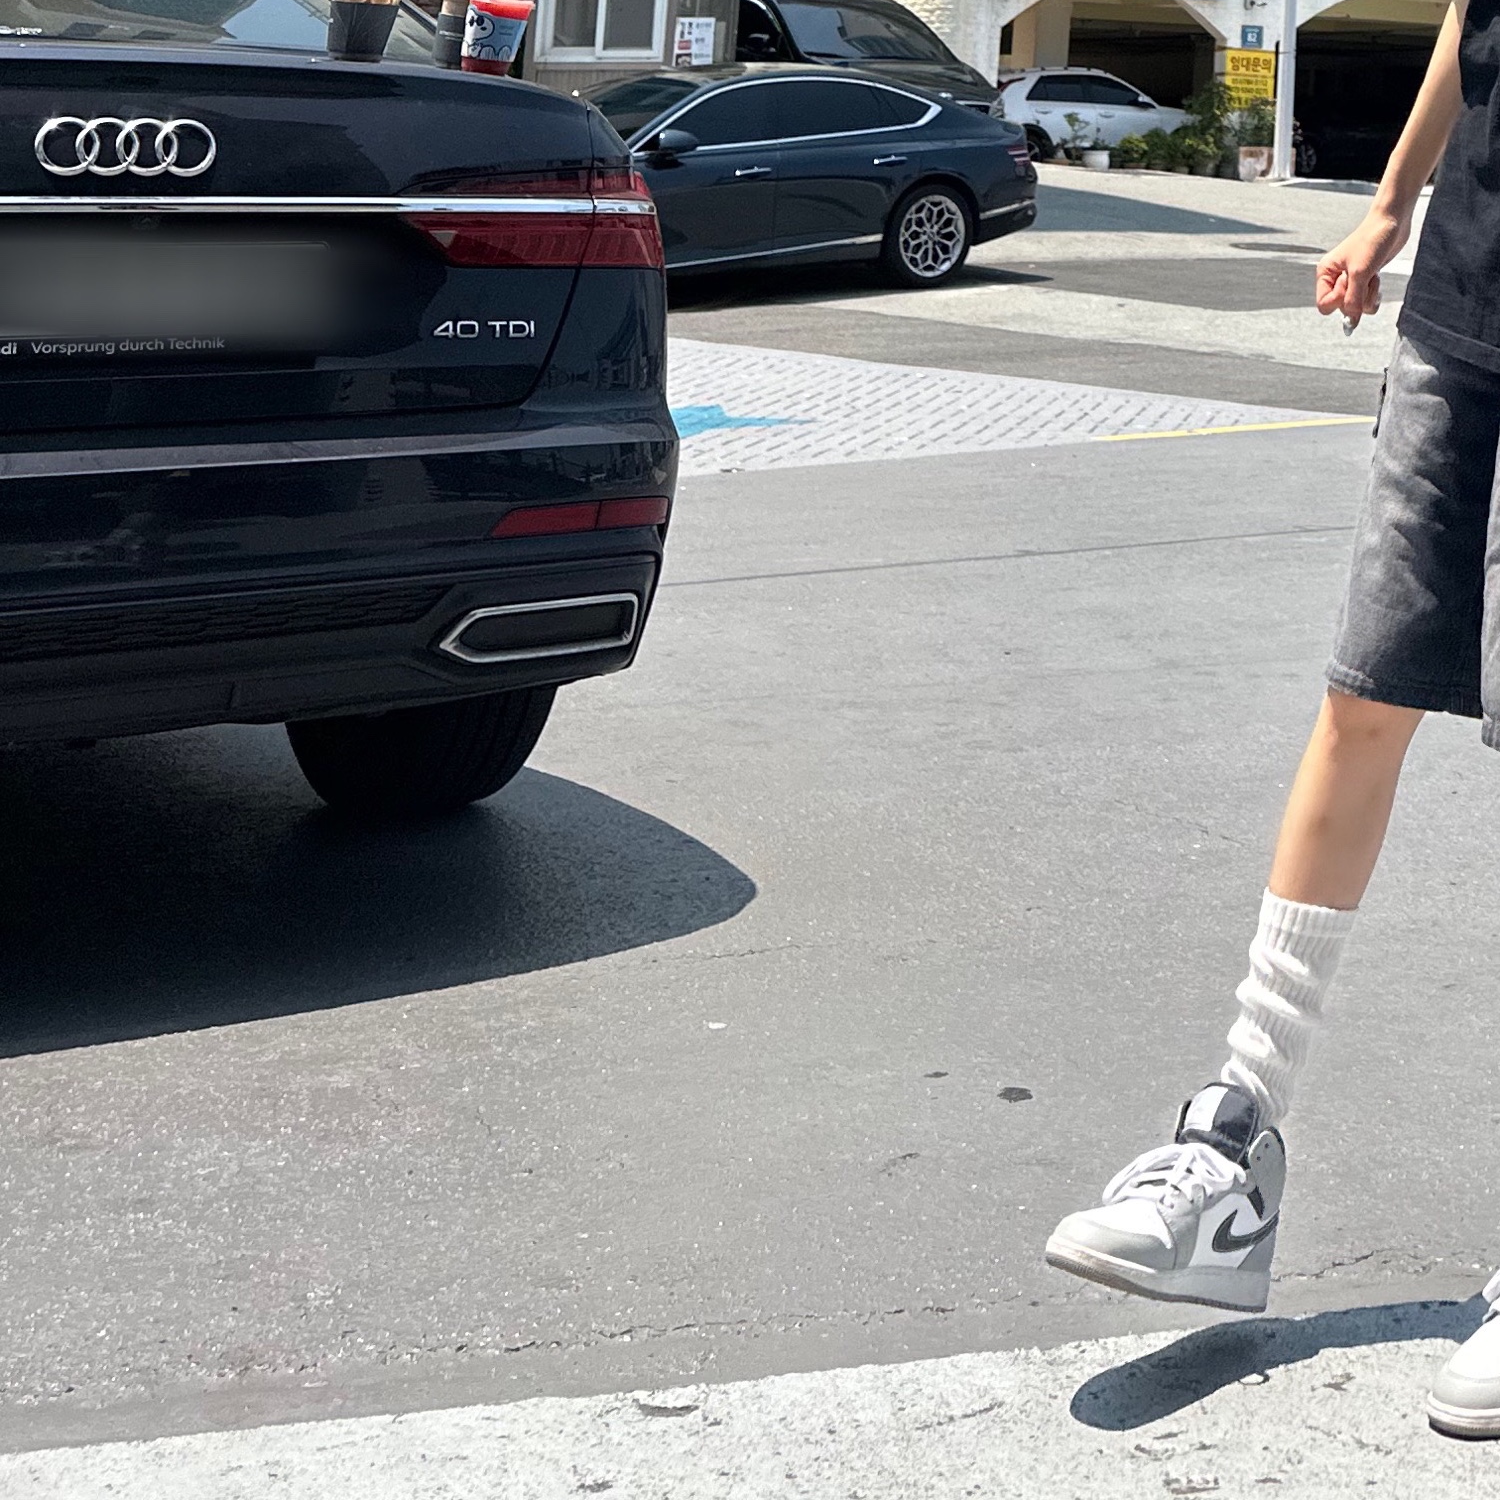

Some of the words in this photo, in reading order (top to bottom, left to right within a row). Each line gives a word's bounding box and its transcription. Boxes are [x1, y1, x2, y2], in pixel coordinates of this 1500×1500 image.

[1230, 55, 1273, 73] 임대문의
[433, 320, 479, 338] 40
[487, 320, 535, 338] TDI
[31, 341, 116, 356] Vorsprung
[119, 338, 164, 352] durch
[167, 336, 225, 350] Technik
